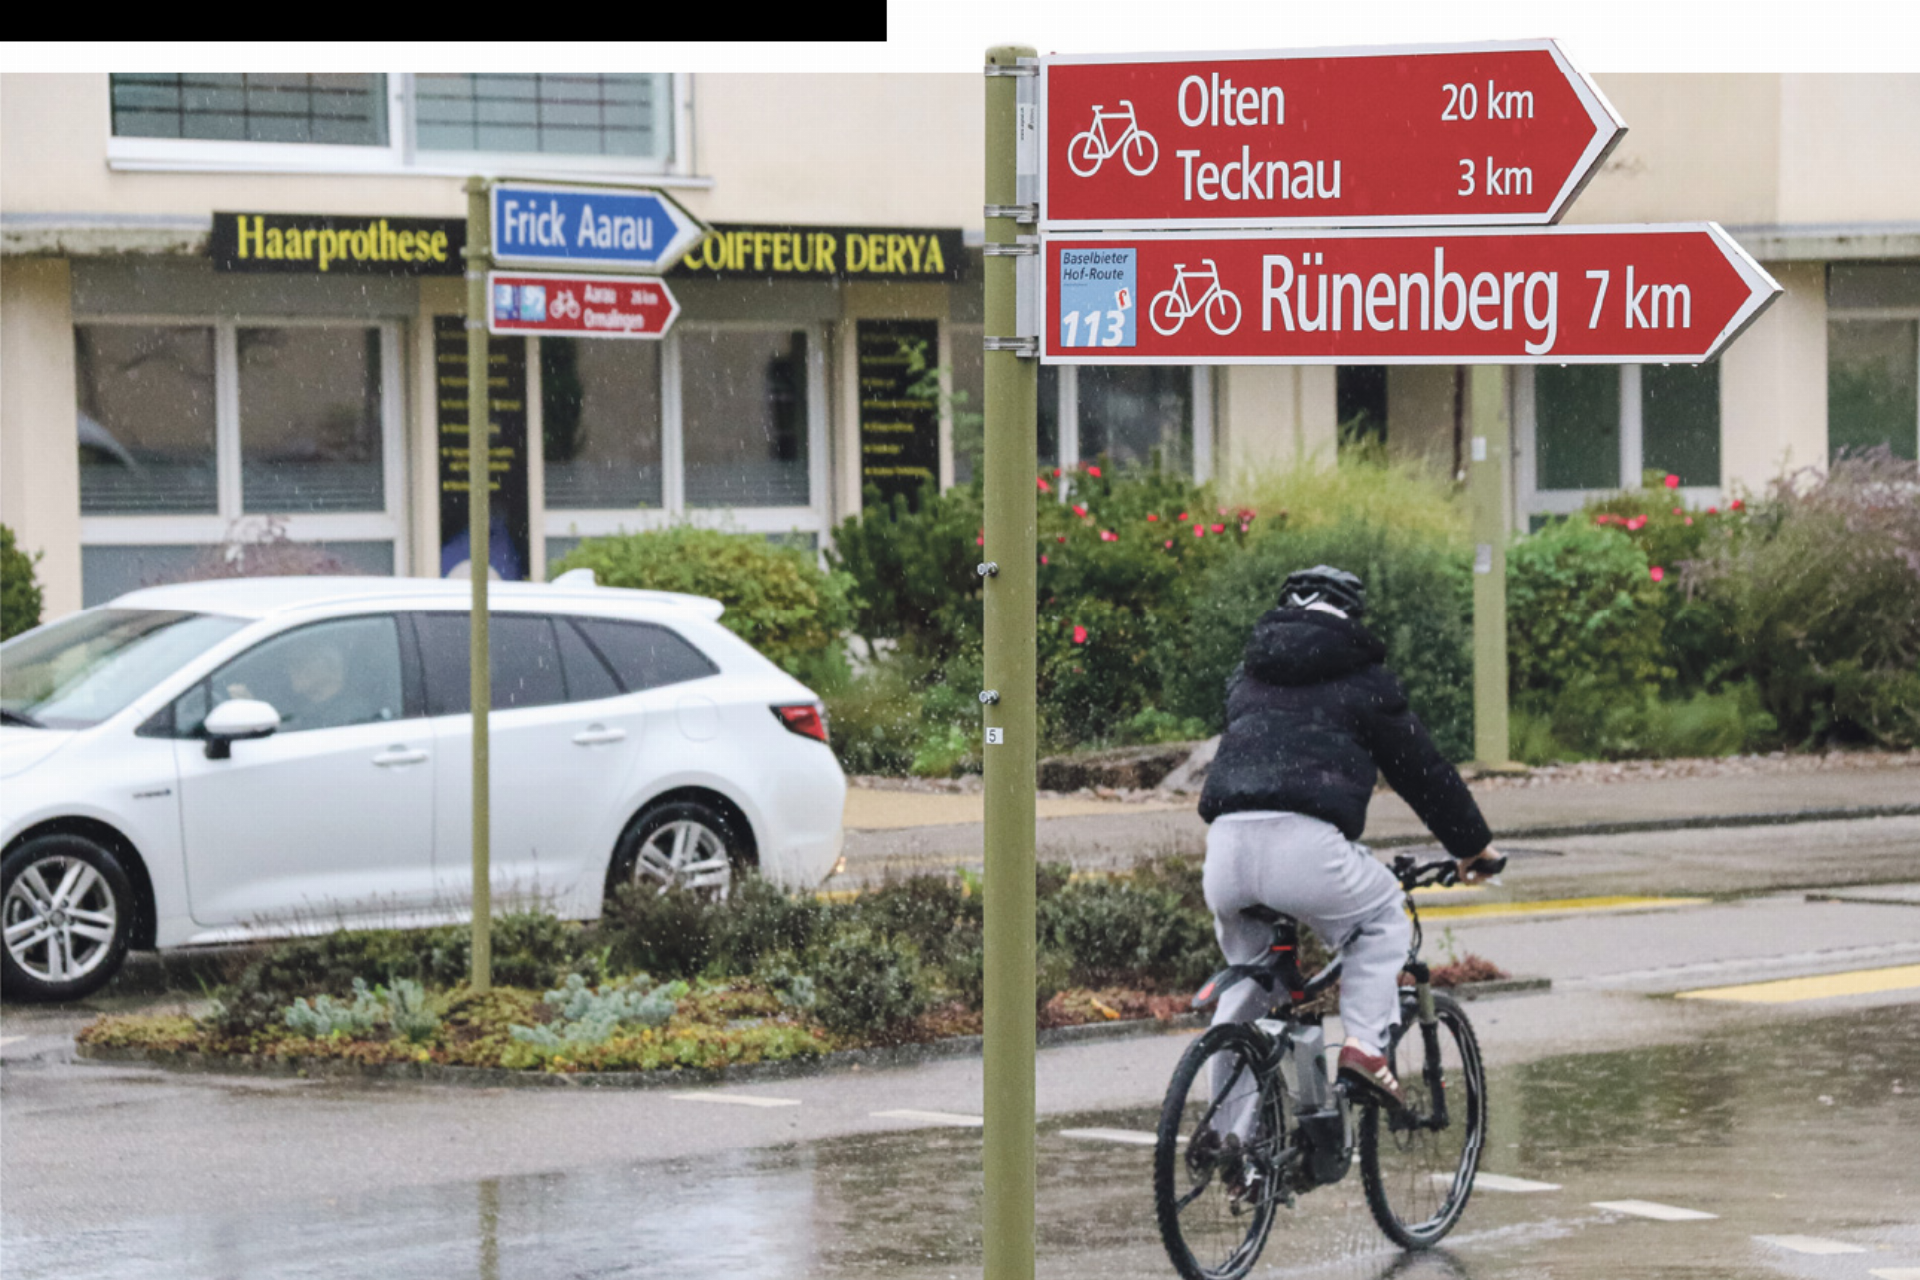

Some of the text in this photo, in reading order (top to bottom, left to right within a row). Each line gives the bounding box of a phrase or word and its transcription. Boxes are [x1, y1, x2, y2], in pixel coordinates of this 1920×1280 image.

[1176, 72, 1533, 127] Olten 20 km
[1176, 145, 1532, 201] Tecknau 3 km
[237, 215, 448, 271] Haarprothese
[504, 200, 654, 250] Frick Aarau
[845, 233, 945, 274] DERYA
[1063, 251, 1129, 265] Baselbieter
[1063, 267, 1124, 281] Hof-Route
[1261, 246, 1691, 356] Rünenberg 7 km
[1063, 310, 1126, 348] 113
[989, 728, 997, 743] 5
